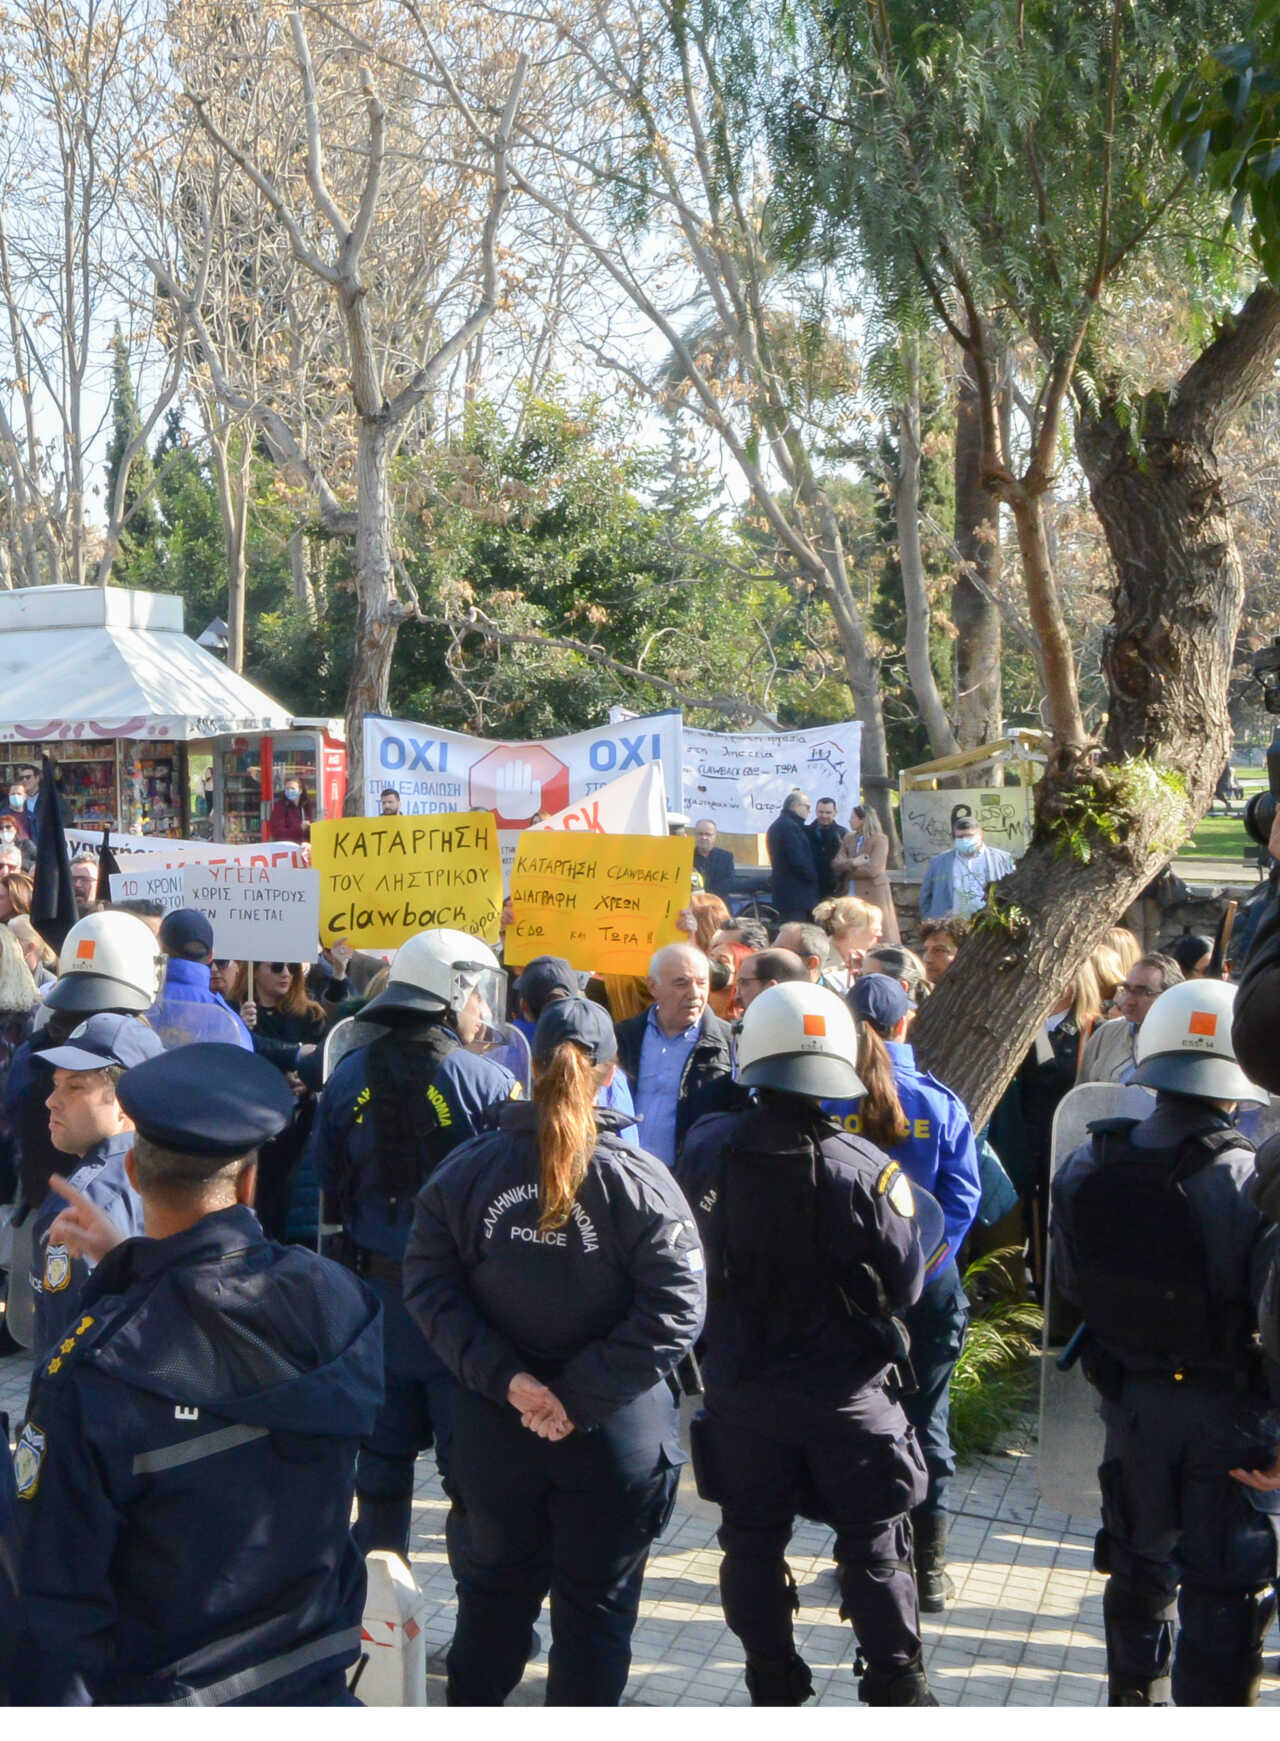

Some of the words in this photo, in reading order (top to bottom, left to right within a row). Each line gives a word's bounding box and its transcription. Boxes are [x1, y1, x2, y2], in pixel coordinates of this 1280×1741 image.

[380, 736, 448, 773] ΟΧΙ
[589, 732, 661, 772] ΟΧΙ
[399, 780, 462, 797] ΕΞΑΘΛΙΩΣΗ
[333, 825, 489, 860] ΚΑΤΑΡΓΗΣΗ
[208, 867, 271, 884] ΥΓΕΙΑ
[329, 873, 365, 893] ΤΟΥ
[376, 867, 489, 892] ΛΗΣΤΡΙΚΟΥ
[517, 856, 598, 880] ΚΑΤΑΡΓΗΣΗ
[607, 864, 671, 882] CLAWBACK
[243, 888, 306, 902] ΓΙΑΤΡΟΥΣ
[513, 888, 577, 910] ΔΙΑΓΡΑΦΗ
[594, 895, 641, 912] ΧΡΕΩΝ
[229, 909, 285, 921] ΓΙΝΕΤΑΙ
[483, 1183, 539, 1239] ΕΛΛΗΝΙΚΗ
[510, 1226, 567, 1247] POLICE
